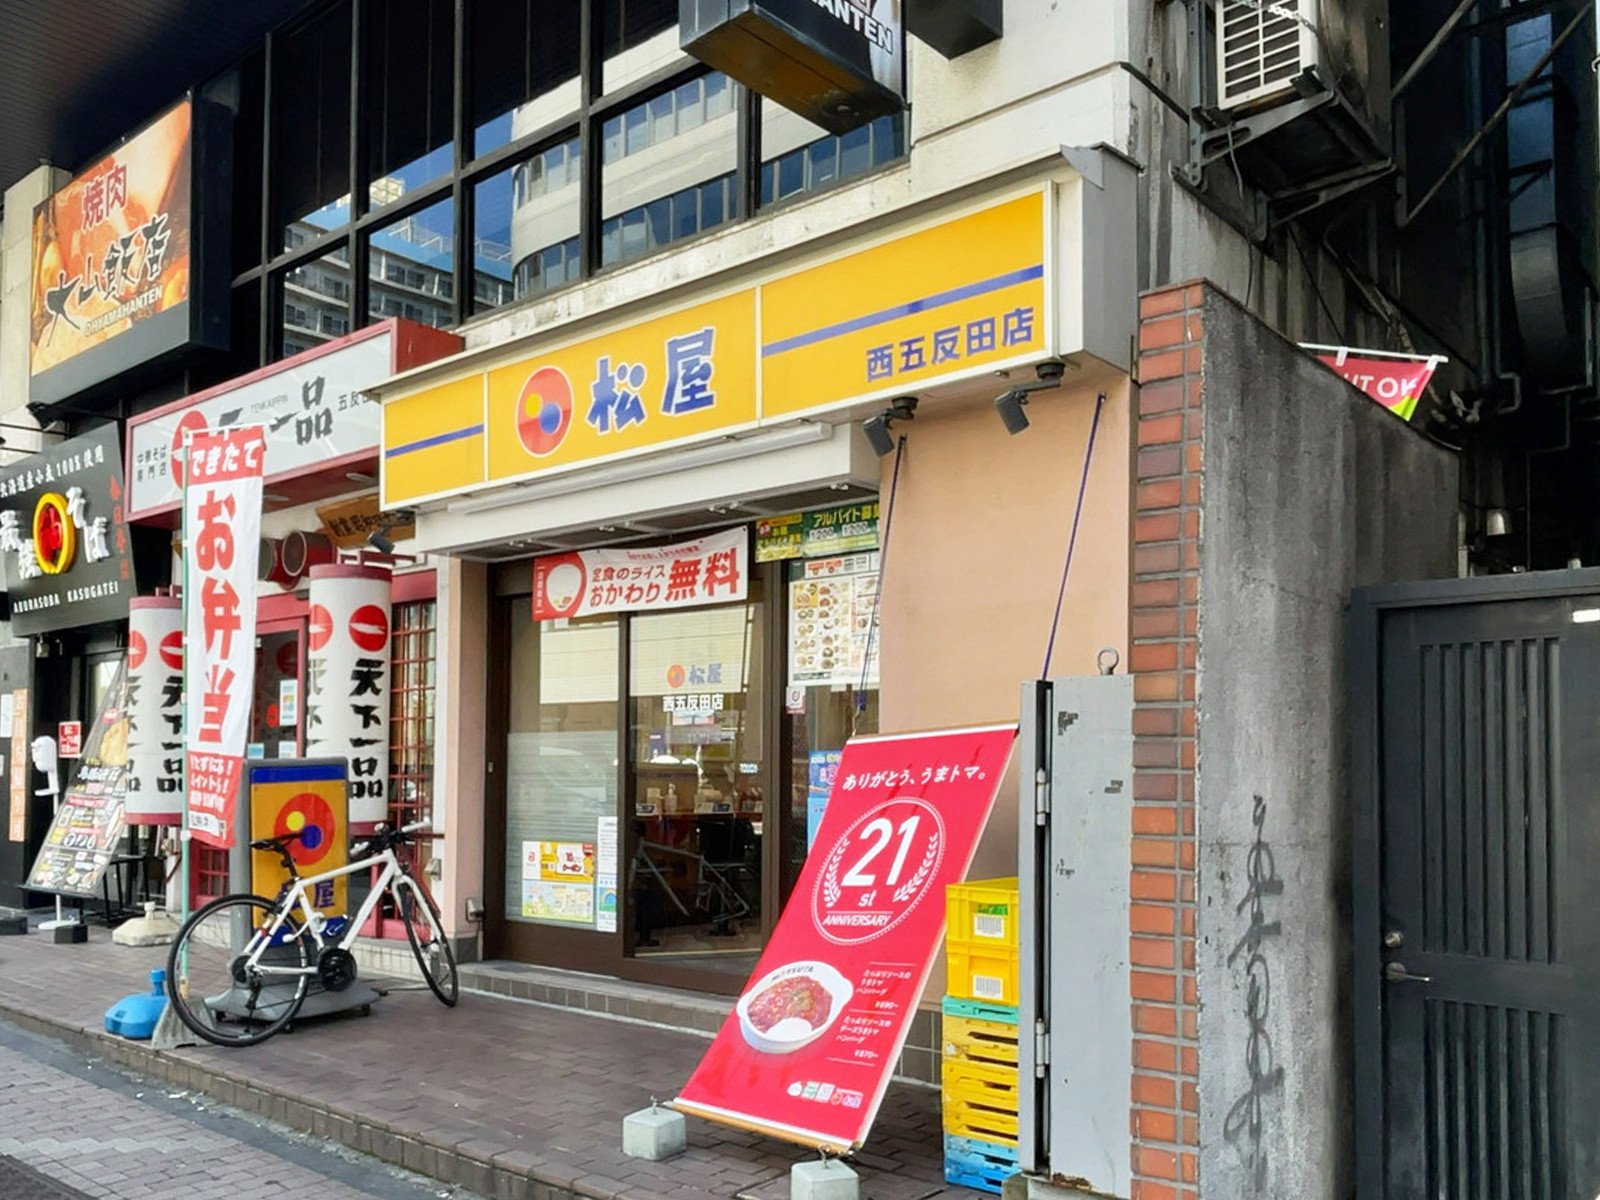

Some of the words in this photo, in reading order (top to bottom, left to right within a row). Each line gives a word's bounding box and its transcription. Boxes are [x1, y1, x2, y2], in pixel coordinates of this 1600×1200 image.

[82, 163, 127, 233] 焼肉
[865, 306, 1035, 383] 西五反田店
[585, 327, 718, 434] 松屋
[191, 438, 262, 478] できたて
[591, 564, 666, 583] 定食のライス
[664, 547, 741, 602] 無料
[66, 580, 120, 603] KASUGATEI
[590, 582, 661, 608] おかわり
[195, 489, 241, 744] お弁当
[688, 662, 722, 685] 松屋
[662, 693, 724, 712] 西五反田店
[348, 658, 385, 799] 天下一品
[842, 765, 987, 791] ありがとう、うまトマ。
[840, 815, 921, 887] 21
[858, 889, 877, 907] st
[822, 914, 892, 927] ANNIVERSARY
